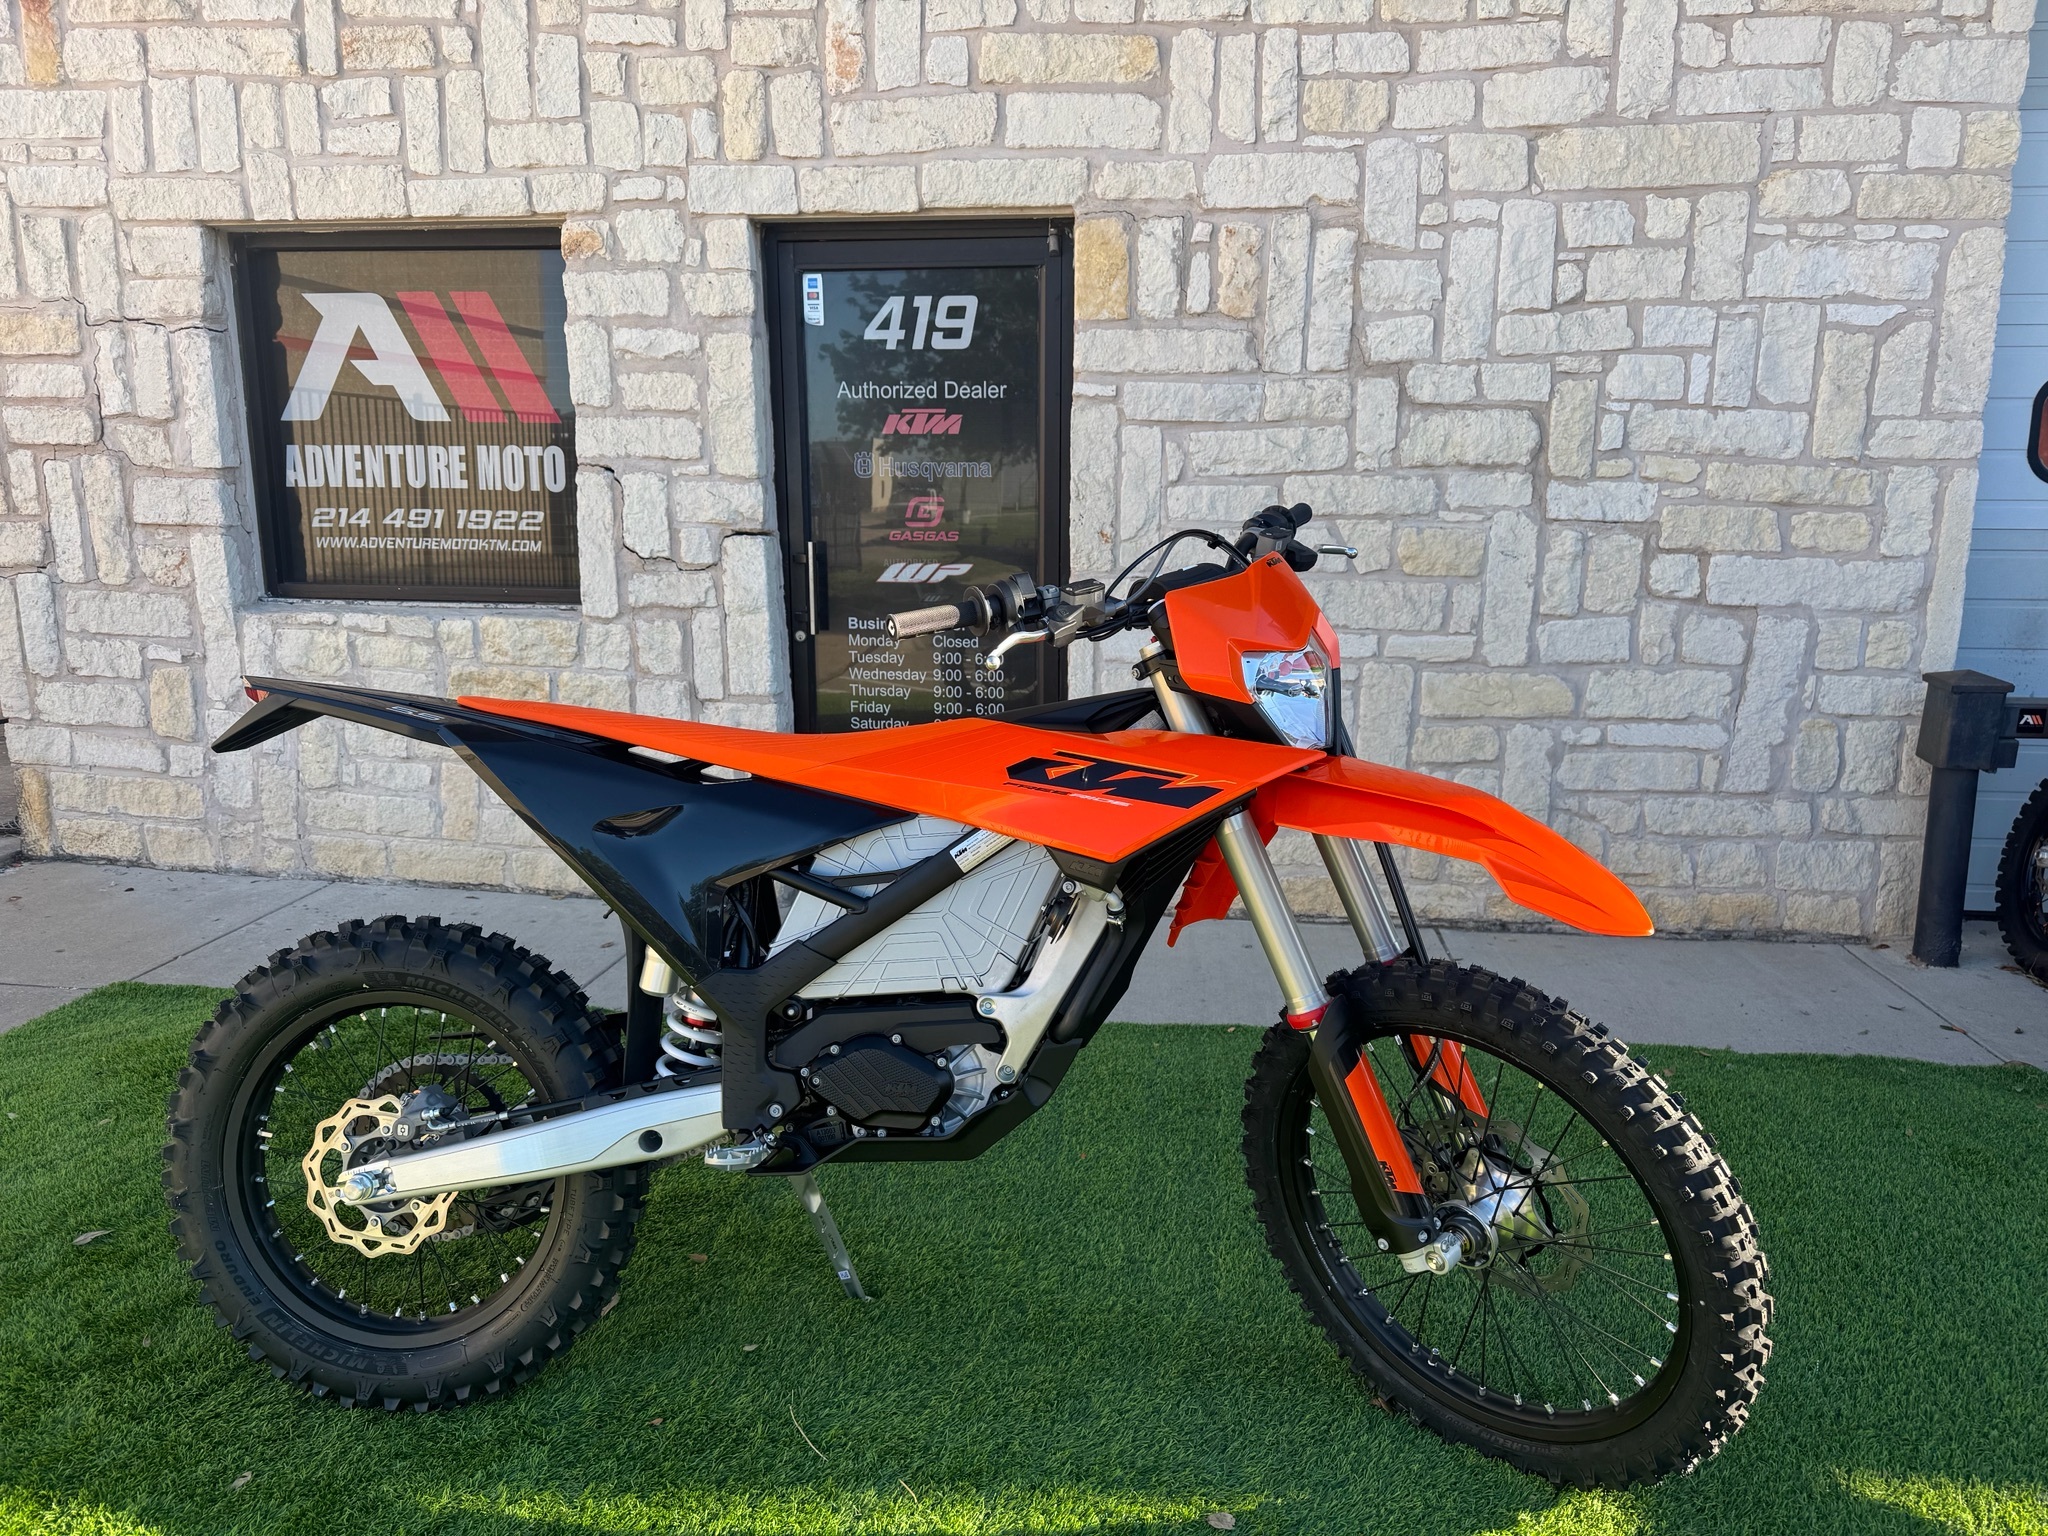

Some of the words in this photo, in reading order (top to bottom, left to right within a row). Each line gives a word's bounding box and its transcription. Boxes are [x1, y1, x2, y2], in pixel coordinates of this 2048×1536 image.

[864, 294, 979, 350] 419
[837, 381, 937, 399] Authorized
[944, 381, 1007, 399] Dealer
[882, 408, 963, 434] KTM
[285, 444, 468, 489] ADVENTURE
[476, 445, 566, 493] MOTO
[878, 456, 992, 482] Husqvarna
[311, 507, 371, 528] 214
[382, 508, 445, 529] 491
[456, 509, 545, 531] 1922
[316, 536, 542, 552] WWW.ADVENTUREMOTOKTM.COM
[888, 530, 960, 542] GASGAS
[876, 562, 974, 584] WP
[848, 633, 900, 650] Monday
[932, 634, 979, 648] Closed
[848, 650, 905, 667] Tuesday
[933, 652, 962, 665] 9:00
[848, 667, 927, 684] Wednesday
[933, 668, 962, 682] 9:00
[975, 669, 1005, 682] 6:00
[849, 684, 911, 700] Thursday
[933, 685, 963, 698] 9:00
[975, 686, 1005, 699] 6:00
[850, 700, 891, 716] Friday
[933, 702, 963, 715] 9:00
[975, 703, 1005, 716] 6:00
[850, 716, 910, 730] Saturday
[1005, 748, 1225, 810] KTM
[405, 975, 516, 1031] MICHELIN
[562, 1188, 579, 1235] TUBETYPE
[213, 1238, 262, 1308] ENDURO
[261, 1309, 369, 1370] MICHELIN
